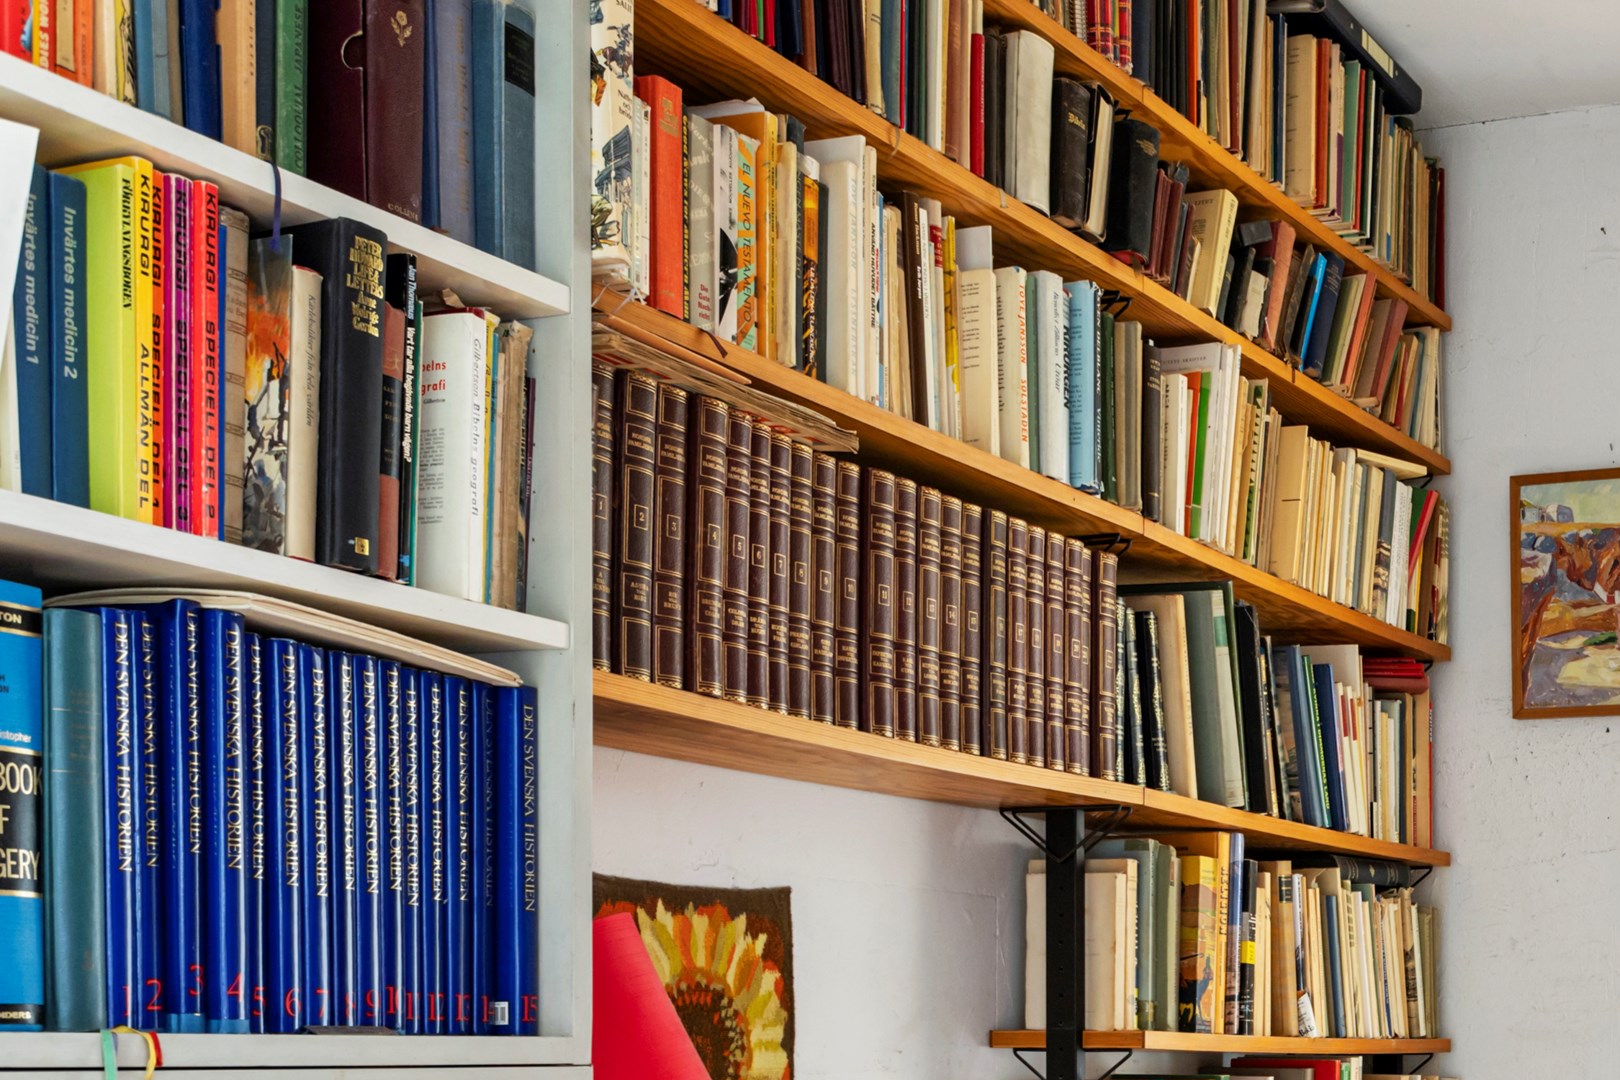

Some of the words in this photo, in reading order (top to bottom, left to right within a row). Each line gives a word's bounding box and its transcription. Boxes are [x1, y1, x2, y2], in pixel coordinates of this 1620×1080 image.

[743, 162, 751, 177] EL
[140, 174, 151, 276] KIRURGI
[743, 183, 752, 231] NUEVO
[63, 206, 77, 284] Invärtes
[152, 185, 162, 287] KIRURGI
[176, 189, 187, 292] KIRURGI
[206, 191, 216, 292] KIRURGI
[354, 235, 383, 258] PETER
[346, 273, 384, 300] LETTERS
[408, 265, 417, 281] Jan
[743, 237, 752, 322] TESTAMENTO
[1019, 284, 1027, 311] TOVE
[25, 275, 39, 351] medicin
[64, 288, 78, 363] medicin
[406, 326, 416, 344] Vart
[26, 354, 39, 364] 1
[405, 345, 415, 358] tar
[1018, 314, 1028, 365] JANSSON
[63, 365, 78, 379] 2
[152, 313, 162, 427] SPECIELL
[176, 319, 187, 438] SPECIELL
[205, 319, 216, 437] SPECIELL
[405, 359, 414, 373] alla
[472, 337, 482, 397] Gilbertson
[140, 343, 152, 447] ALLMÄN
[1019, 378, 1029, 443] SOLSTADEN
[404, 413, 413, 432] barn
[140, 459, 150, 509] DEL
[176, 446, 188, 495] DEL
[205, 446, 215, 495] DEL
[470, 457, 479, 516] geografi
[176, 509, 188, 521] 3
[205, 506, 215, 518] 2
[115, 621, 128, 665] DEN
[141, 620, 154, 664] DEN
[186, 611, 198, 653] DEN
[226, 629, 240, 671] DEN
[250, 644, 261, 685] DEN
[282, 654, 296, 695] DEN
[311, 668, 324, 708] DEN
[363, 670, 375, 709] DEN
[386, 669, 399, 709] DEN
[115, 670, 130, 757] SVENSKA
[142, 669, 156, 755] SVENSKA
[187, 658, 199, 742] SVENSKA
[226, 676, 241, 759] SVENSKA
[405, 689, 417, 726] DEN
[523, 704, 534, 741] DEN
[251, 690, 262, 771] SVENSKA
[283, 700, 297, 780] SVENSKA
[313, 712, 325, 792] SVENSKA
[364, 713, 376, 791] SVENSKA
[387, 713, 400, 789] SVENSKA
[189, 750, 200, 854] HISTORIEN
[523, 745, 534, 816] SVENSKA
[1323, 786, 1331, 812] LAND
[117, 765, 132, 873] HISTORIEN
[144, 762, 159, 868] HISTORIEN
[227, 766, 242, 871] HISTORIEN
[252, 779, 264, 880] HISTORIEN
[285, 787, 298, 887] HISTORIEN
[315, 799, 328, 898] HISTORIEN
[365, 798, 378, 894] HISTORIEN
[389, 796, 402, 891] HISTORIEN
[524, 823, 535, 912] HISTORIEN
[146, 979, 162, 1011] 2
[189, 964, 204, 996] 3
[226, 972, 243, 1002] 4
[253, 986, 266, 1015] 5
[285, 988, 301, 1018] 6
[365, 989, 380, 1018] 9
